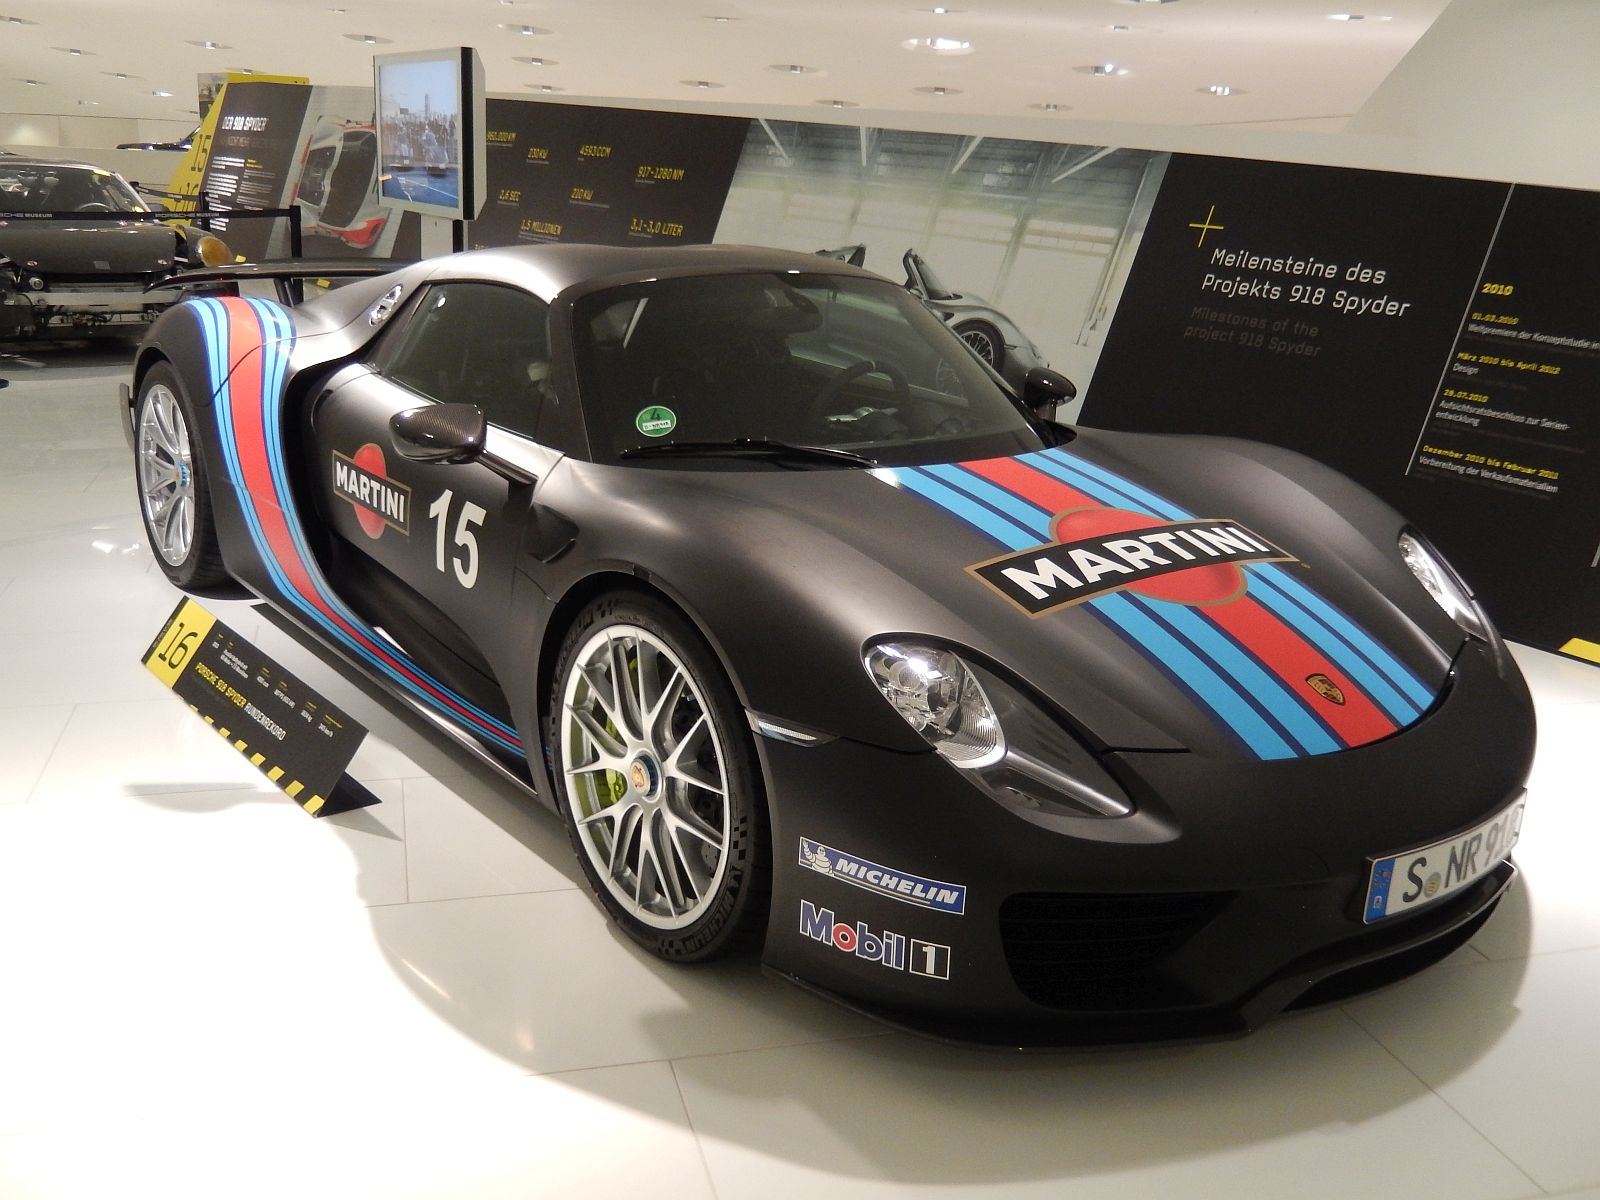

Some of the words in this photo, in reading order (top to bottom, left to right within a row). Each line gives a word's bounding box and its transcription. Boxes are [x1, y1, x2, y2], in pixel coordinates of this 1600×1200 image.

[662, 223, 683, 237] LITER
[1210, 248, 1338, 279] Meilensteine
[1345, 262, 1387, 285] des
[1201, 273, 1282, 300] Projekts
[1289, 284, 1326, 306] 918
[1332, 290, 1411, 317] Spyder
[1481, 283, 1514, 296] 2010
[1184, 325, 1234, 344] project
[1238, 330, 1264, 348] 918
[1268, 336, 1321, 357] Spyder
[1190, 306, 1267, 329] Milestones
[1272, 318, 1288, 332] of
[1294, 321, 1319, 338] the
[1435, 411, 1480, 427] entwicklung
[1419, 455, 1466, 475] Vorbereitung
[1466, 466, 1480, 476] der
[1423, 445, 1463, 459] Dezember
[1486, 458, 1501, 467] bis
[1502, 461, 1536, 475] Februar
[336, 461, 405, 523] MARTINI
[429, 488, 487, 589] 15
[1000, 526, 1271, 600] MARTINI
[158, 622, 199, 670] 16
[195, 662, 220, 685] PORSCHE
[225, 687, 247, 708] SPYDER
[244, 702, 287, 740] RUNDENREKORD
[835, 858, 960, 904] MICHELIN
[1403, 856, 1428, 903] S
[1444, 833, 1483, 889] NR
[799, 899, 906, 971] Mobil
[922, 946, 936, 975] 1
